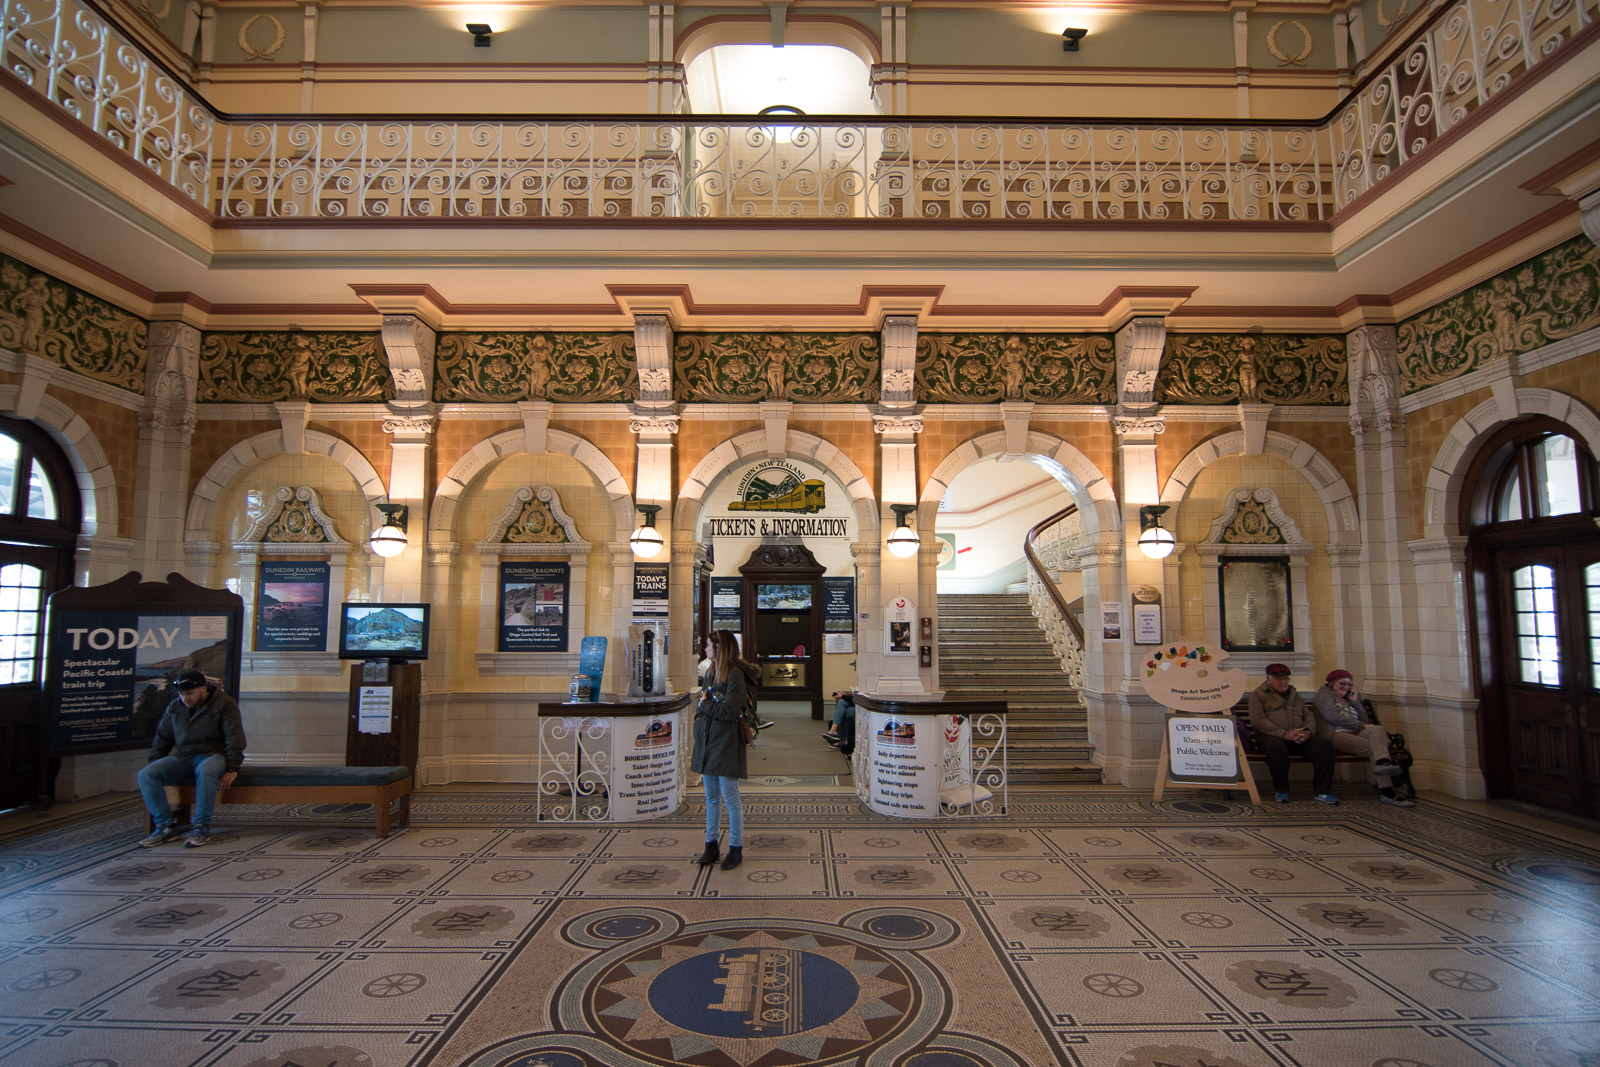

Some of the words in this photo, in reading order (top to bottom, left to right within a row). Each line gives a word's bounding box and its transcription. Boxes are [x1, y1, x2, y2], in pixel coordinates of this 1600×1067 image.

[737, 467, 756, 495] DUNEDIN
[758, 461, 774, 469] NEW
[776, 461, 806, 479] ZEALAND
[710, 518, 756, 536] TICKETS
[760, 518, 769, 536] &
[772, 518, 847, 536] INFORMATION
[66, 628, 180, 650] TODAY
[64, 658, 120, 668] Spectacular
[63, 669, 96, 678] Pacific
[97, 668, 133, 677] Coastal
[88, 680, 105, 688] trip
[878, 778, 902, 787] Sightseeing
[651, 796, 668, 805] Journeys
